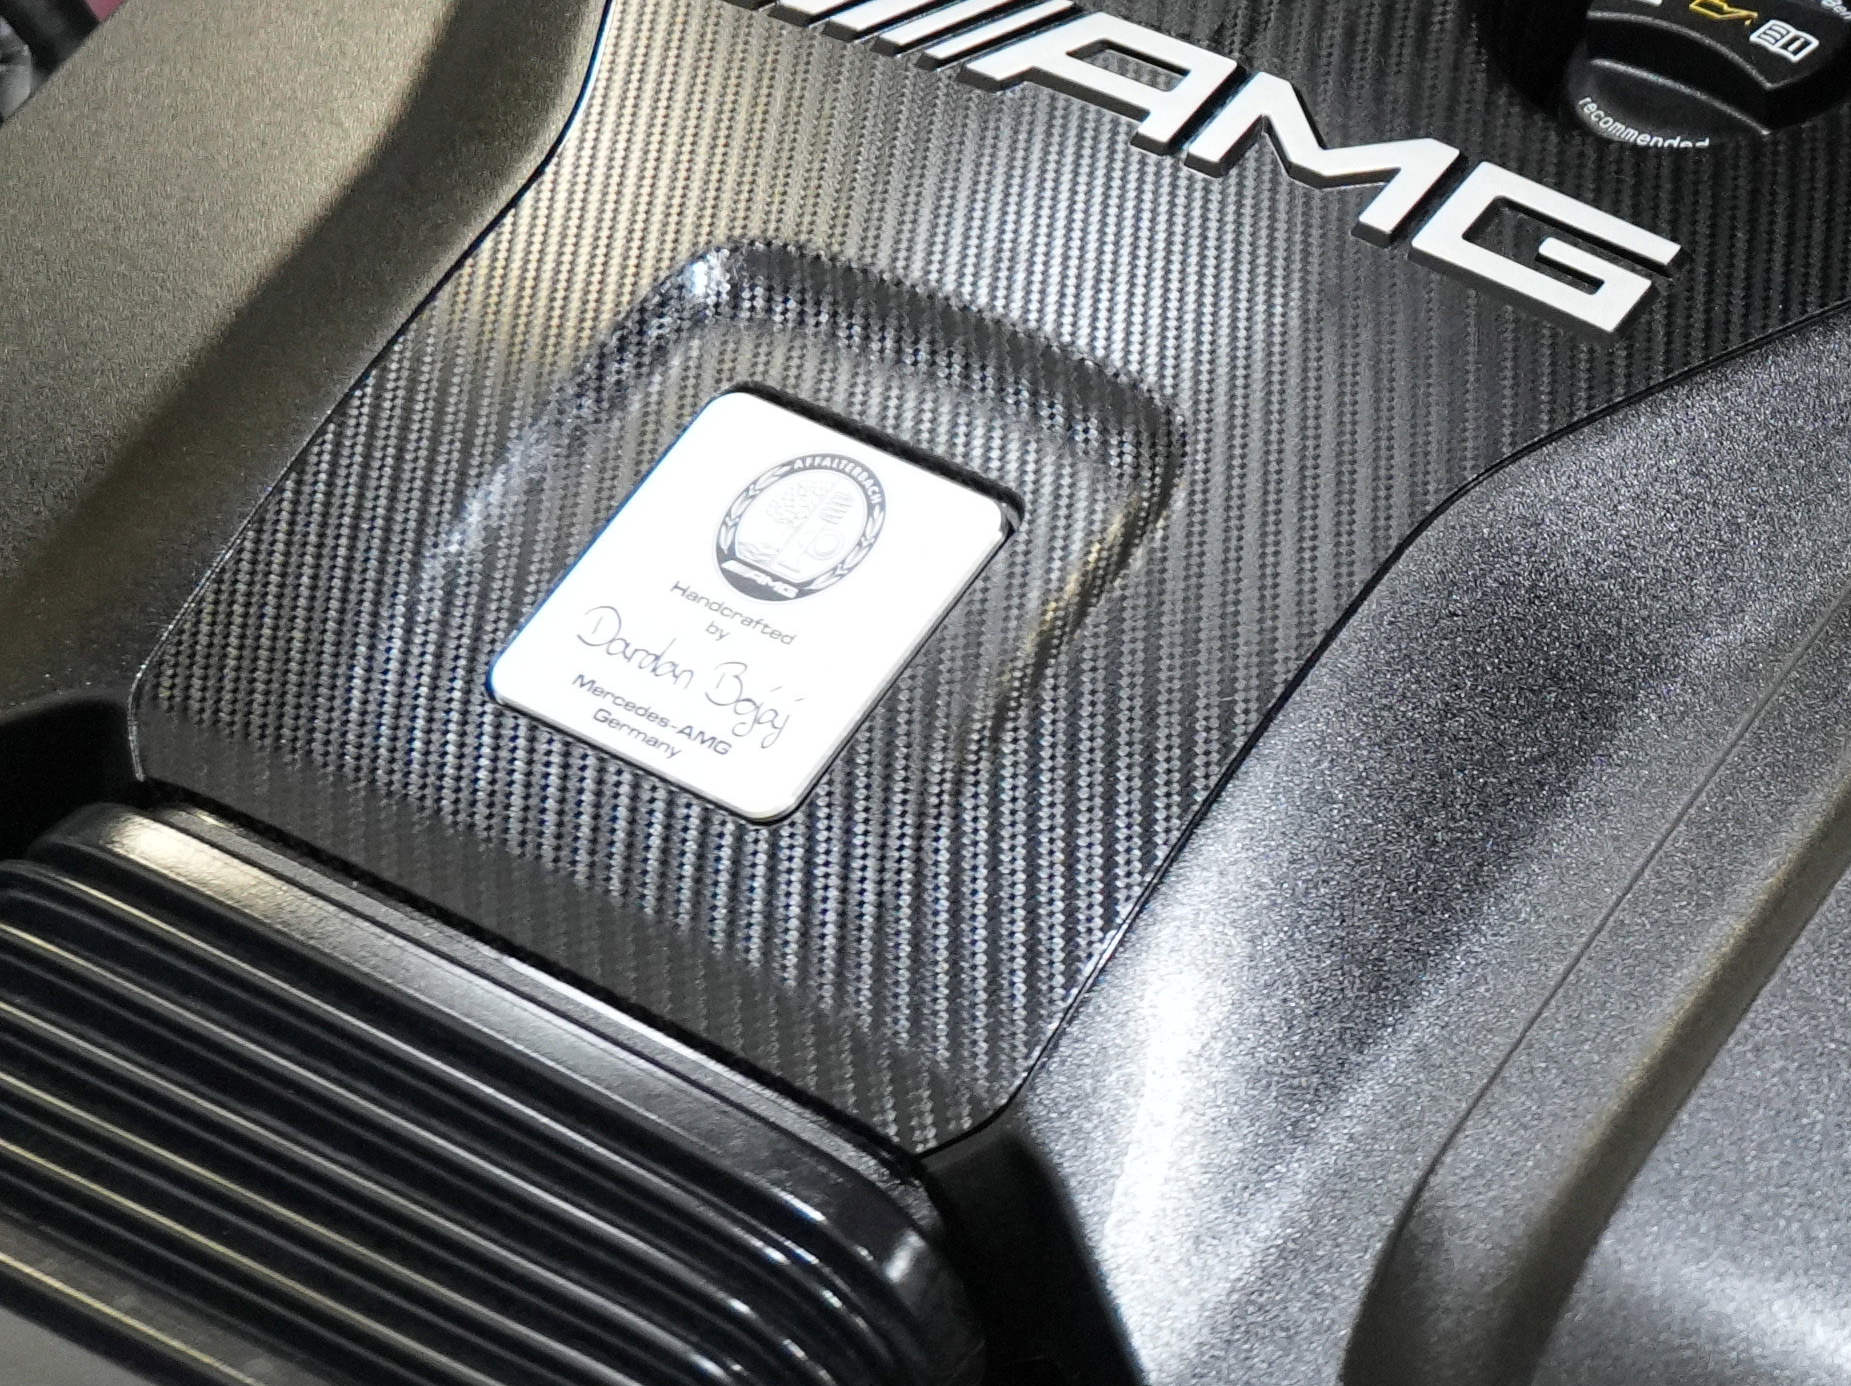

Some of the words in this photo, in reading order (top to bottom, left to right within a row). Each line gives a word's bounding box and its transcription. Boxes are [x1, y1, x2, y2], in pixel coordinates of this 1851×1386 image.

[960, 10, 1691, 337] AMG
[792, 455, 883, 505] AFFALTERBACH
[669, 579, 798, 647] Handcrafted
[704, 619, 731, 643] by
[571, 671, 732, 757] Mercedes-AMG
[591, 706, 685, 761] Germany
